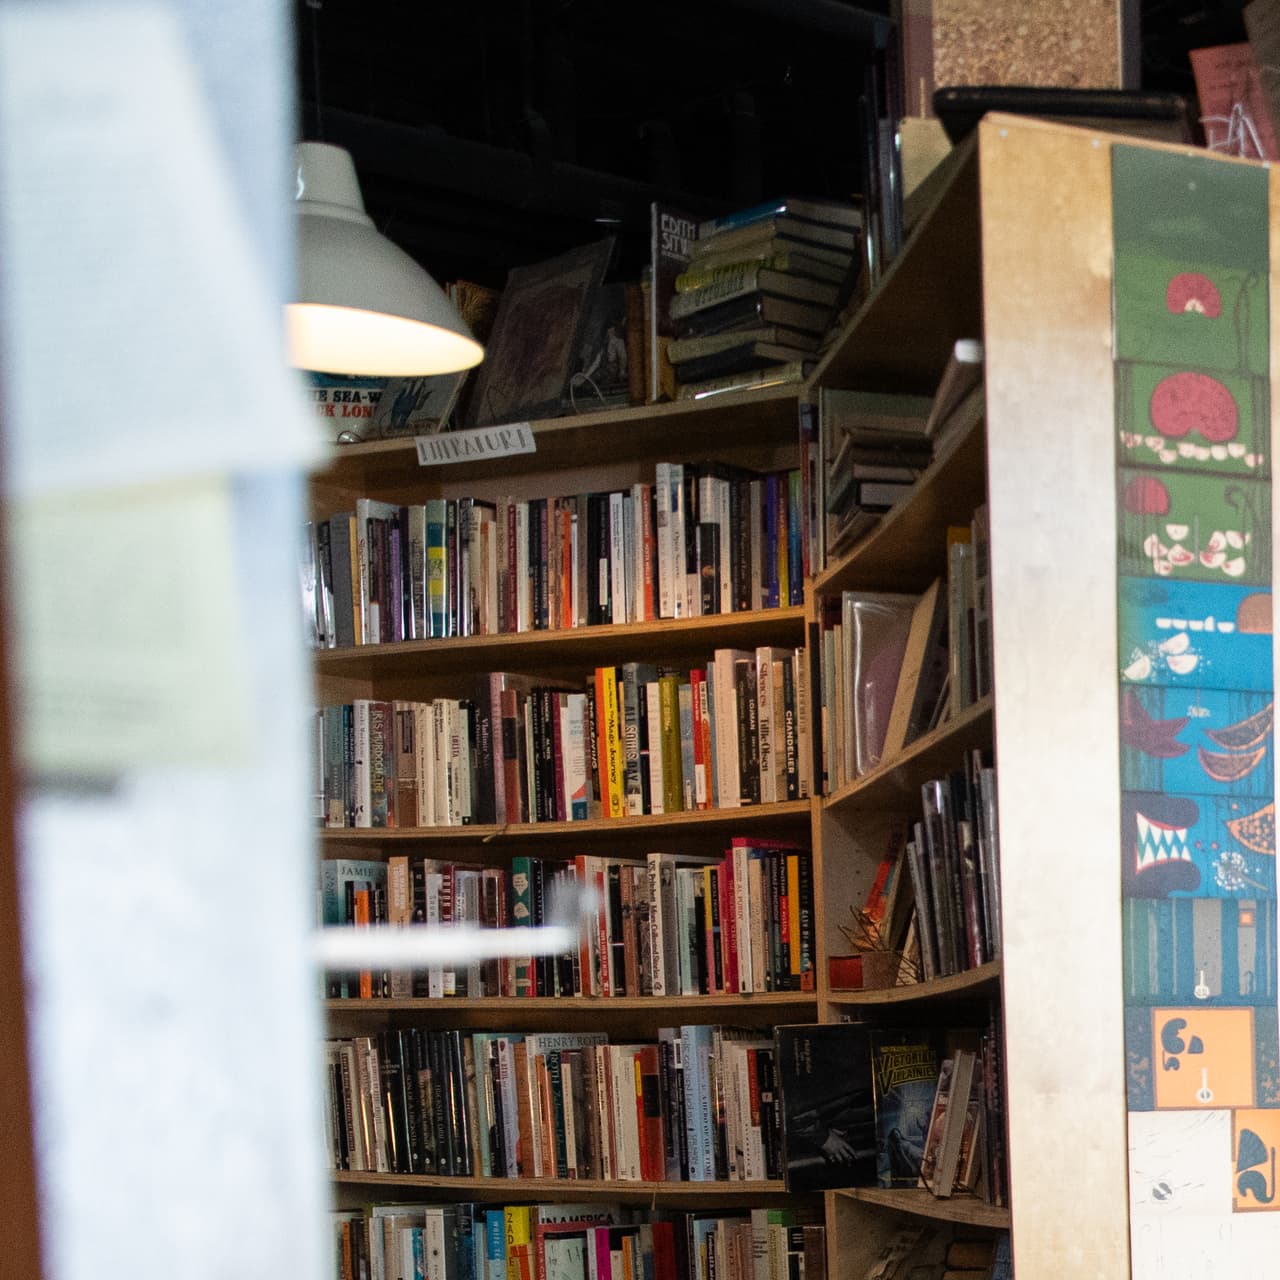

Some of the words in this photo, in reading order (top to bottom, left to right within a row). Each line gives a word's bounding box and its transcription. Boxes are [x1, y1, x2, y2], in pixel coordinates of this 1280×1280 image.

[661, 213, 697, 240] EDITH
[538, 1037, 575, 1049] HENRY
[576, 1036, 609, 1048] ROTH
[506, 1212, 515, 1268] ZADE
